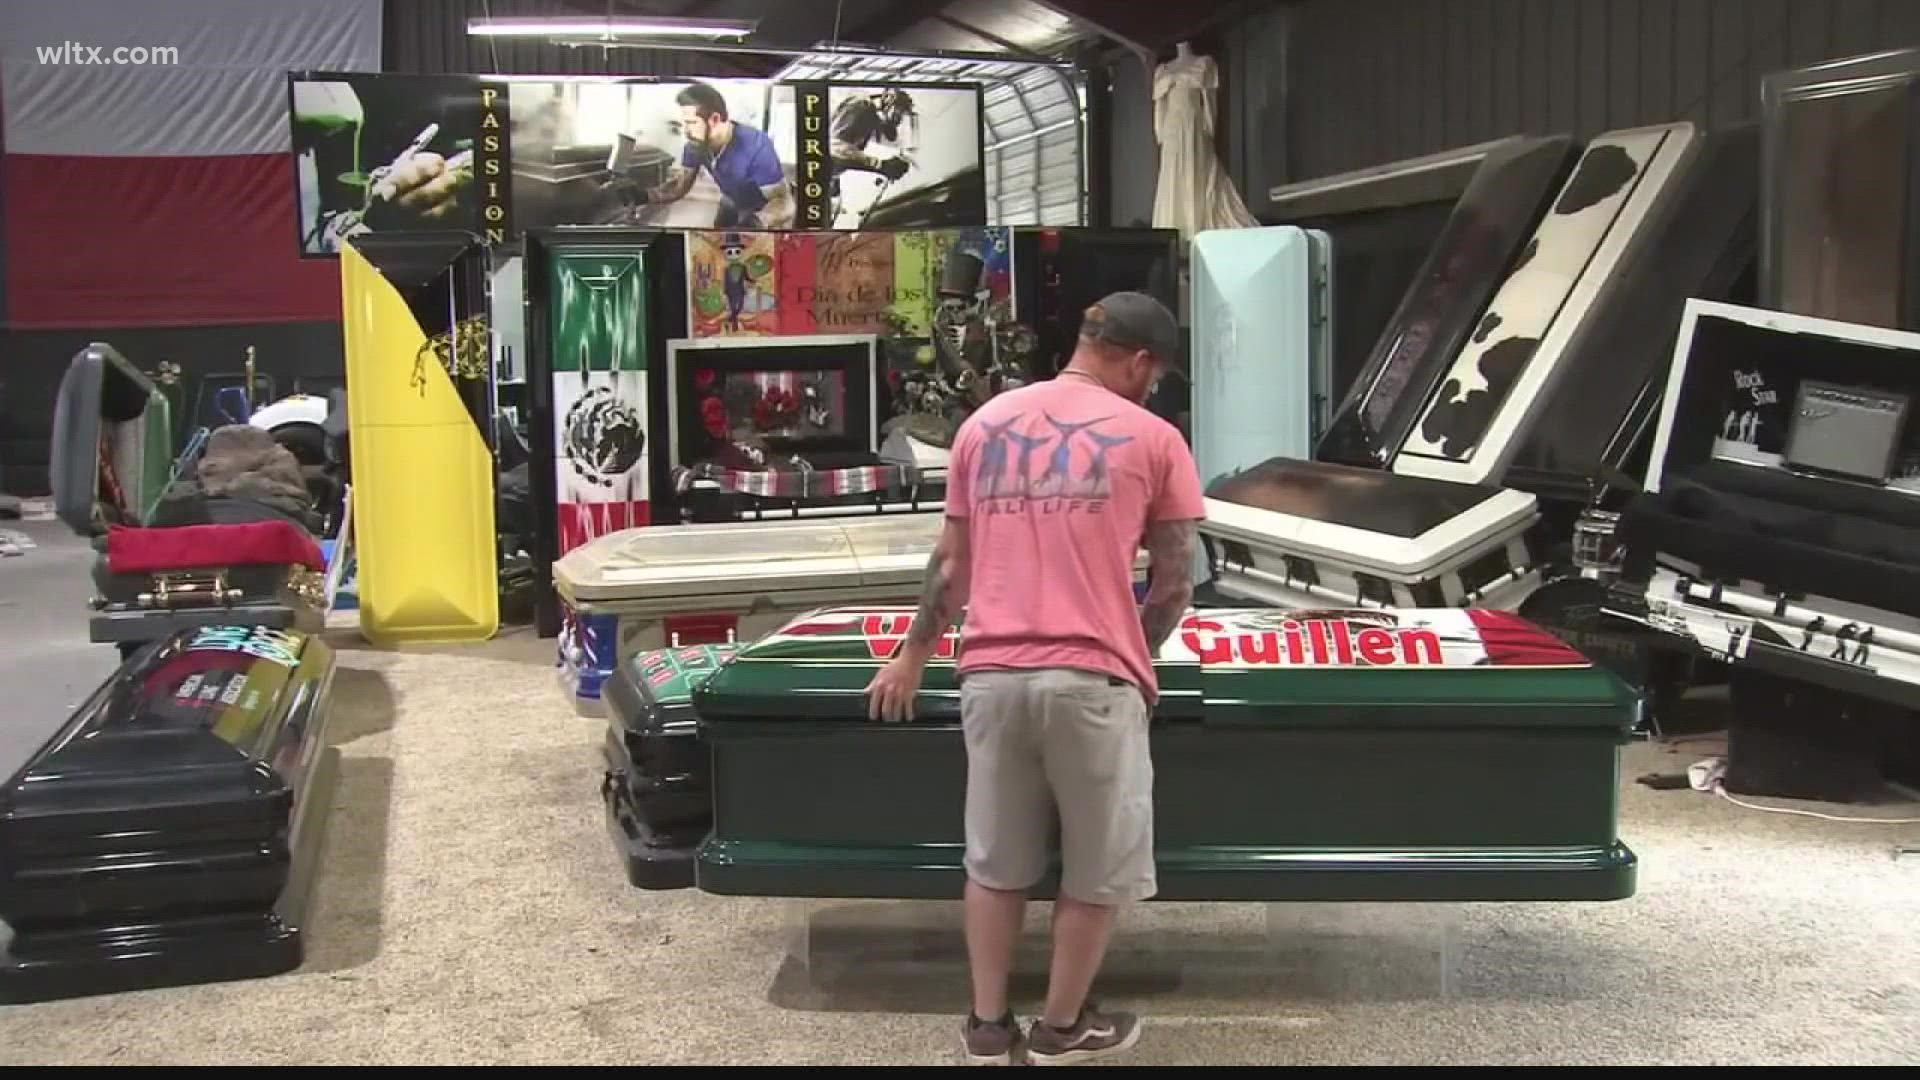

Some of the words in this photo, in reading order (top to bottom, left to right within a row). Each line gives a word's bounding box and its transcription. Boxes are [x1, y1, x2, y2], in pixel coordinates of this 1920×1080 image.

[481, 88, 505, 244] PASSION
[804, 94, 823, 230] PURPOS
[847, 284, 878, 303] de
[805, 308, 900, 327] Muert
[1043, 499, 1105, 514] LIFE
[1180, 616, 1443, 665] Guillen
